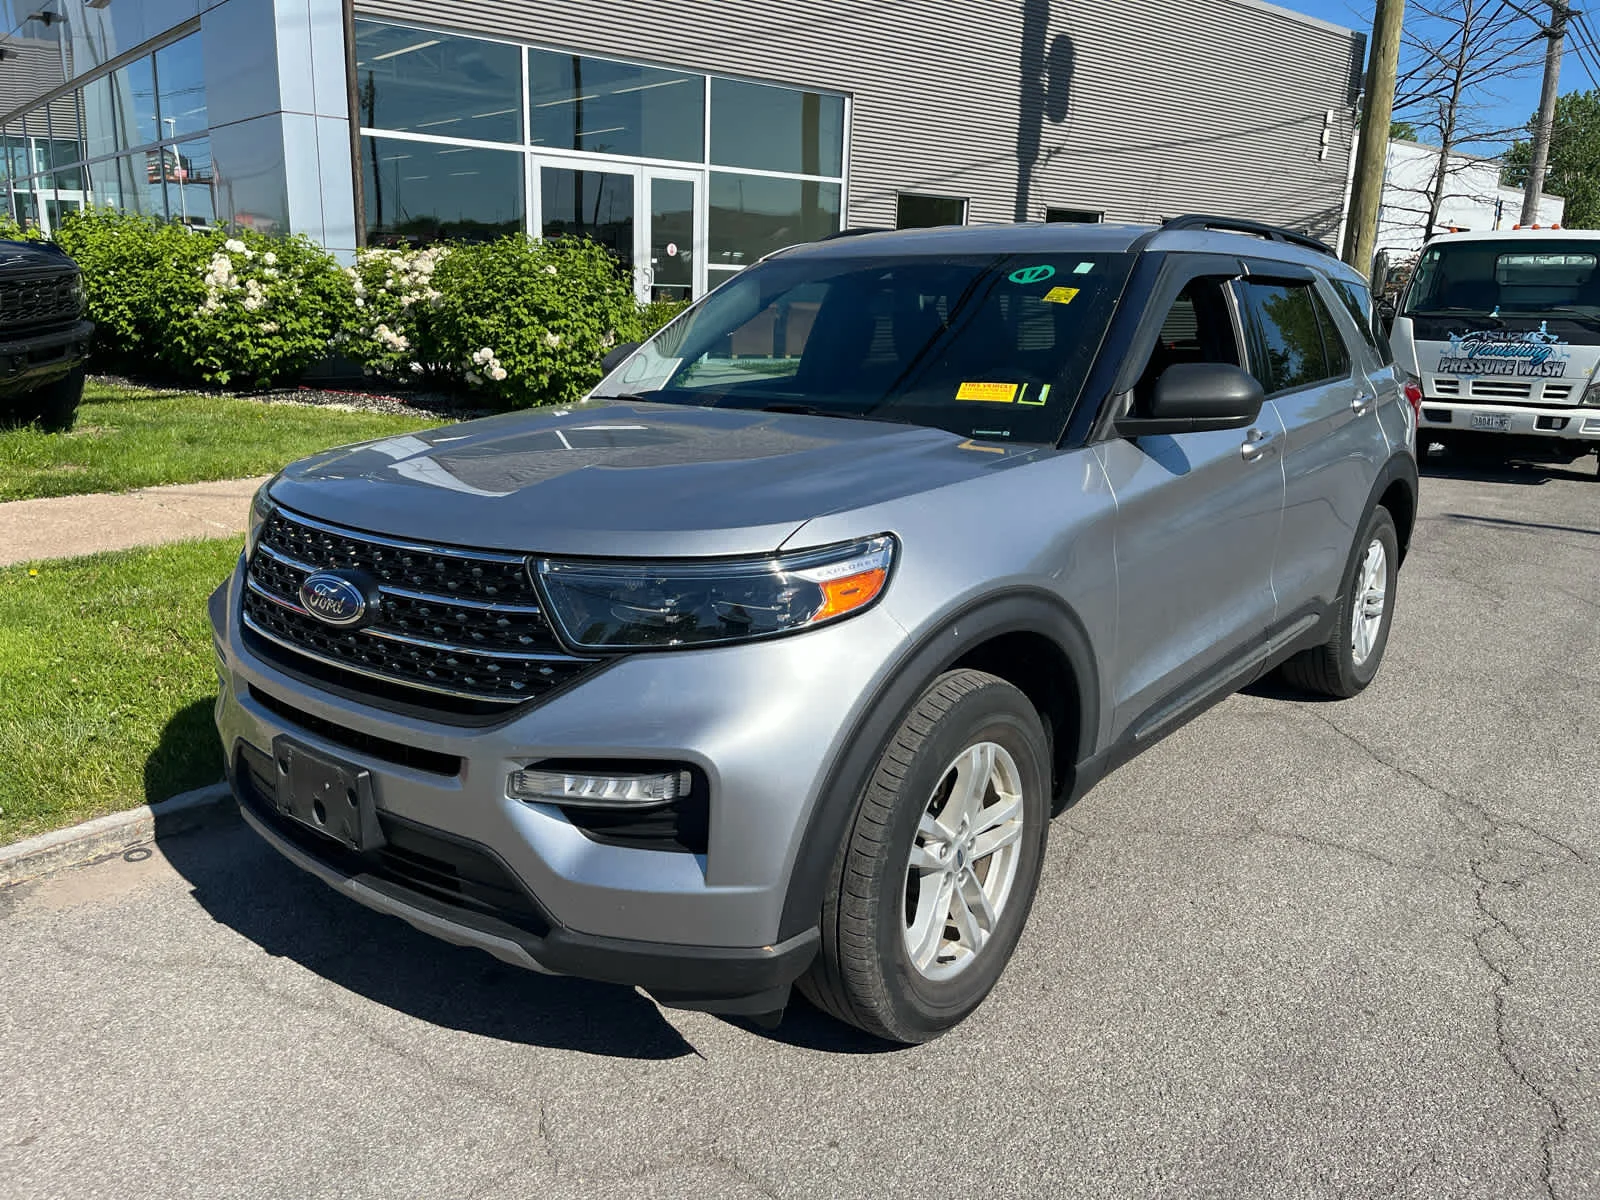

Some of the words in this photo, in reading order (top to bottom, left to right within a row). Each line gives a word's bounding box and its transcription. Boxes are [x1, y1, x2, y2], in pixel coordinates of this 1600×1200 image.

[1463, 339, 1552, 366] Vanishing
[1438, 357, 1516, 375] PRESSURE
[1516, 359, 1566, 378] WASH
[817, 558, 878, 576] EXPLORER
[310, 583, 346, 614] Ford
